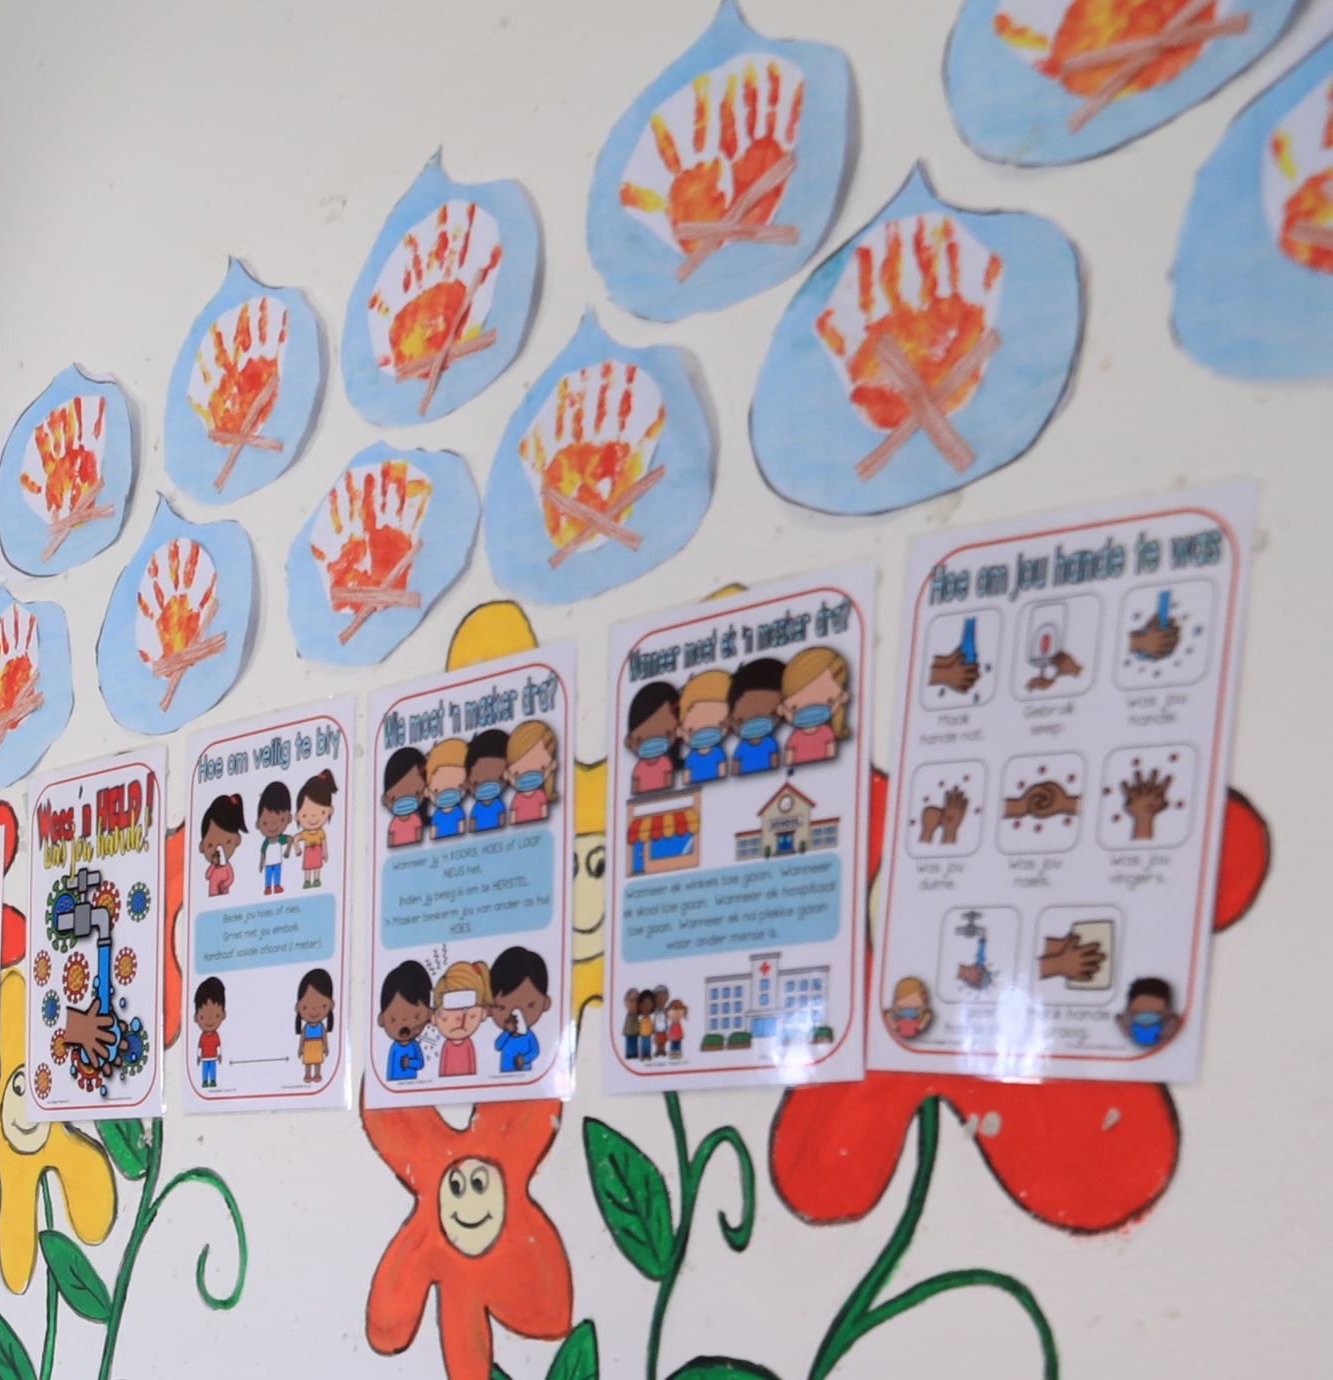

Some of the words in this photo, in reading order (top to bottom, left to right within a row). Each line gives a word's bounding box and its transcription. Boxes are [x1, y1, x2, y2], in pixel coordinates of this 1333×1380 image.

[929, 564, 969, 606] Hoe
[975, 564, 1008, 598] om
[1009, 552, 1048, 601] jou
[1053, 536, 1125, 586] hande
[1135, 530, 1161, 575] te
[1170, 529, 1223, 570] was
[684, 628, 717, 668] moet
[720, 625, 736, 659] ek
[758, 609, 810, 651] masker
[815, 597, 851, 637] dra?
[409, 699, 444, 744] moet
[464, 686, 518, 731] masker
[522, 671, 558, 716] dra?
[198, 755, 223, 784] Hoe
[227, 752, 248, 775] om
[253, 737, 291, 770] veilig
[295, 732, 311, 761] te
[316, 725, 341, 759] bly
[38, 798, 74, 851] Wees
